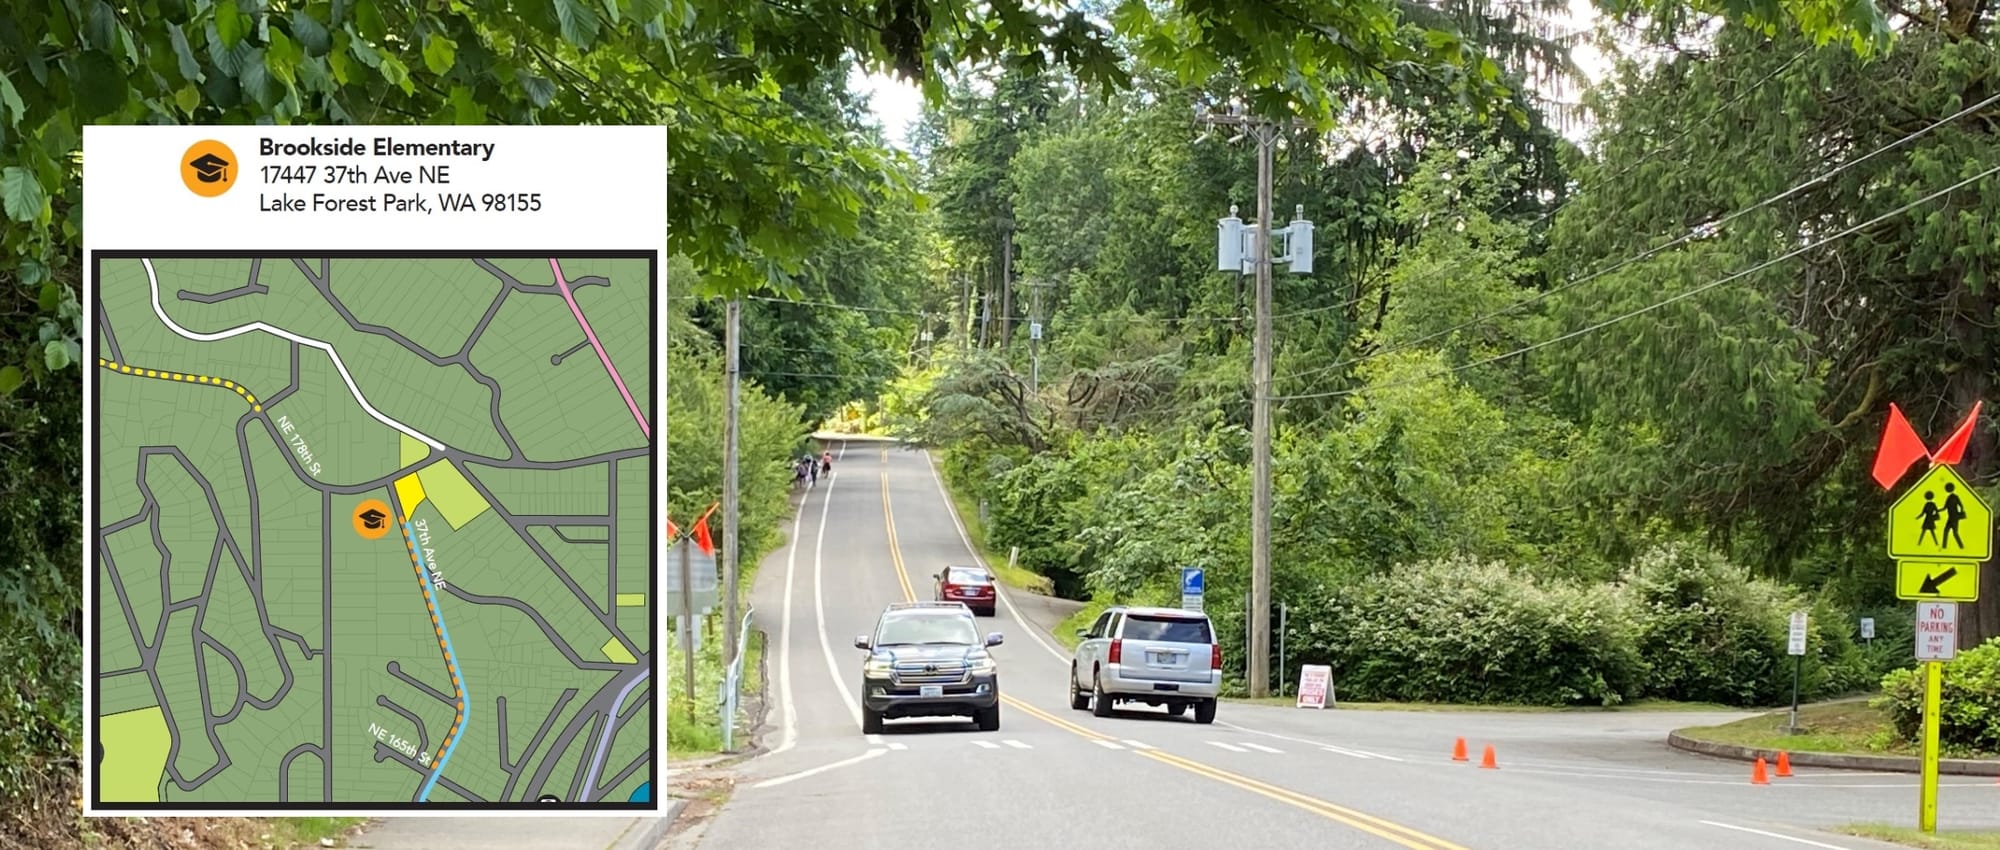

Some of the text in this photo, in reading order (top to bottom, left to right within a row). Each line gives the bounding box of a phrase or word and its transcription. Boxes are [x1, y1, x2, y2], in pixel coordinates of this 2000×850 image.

[1930, 608, 1944, 619] NO
[1920, 622, 1953, 633] PARKING
[1927, 645, 1943, 653] TIME
